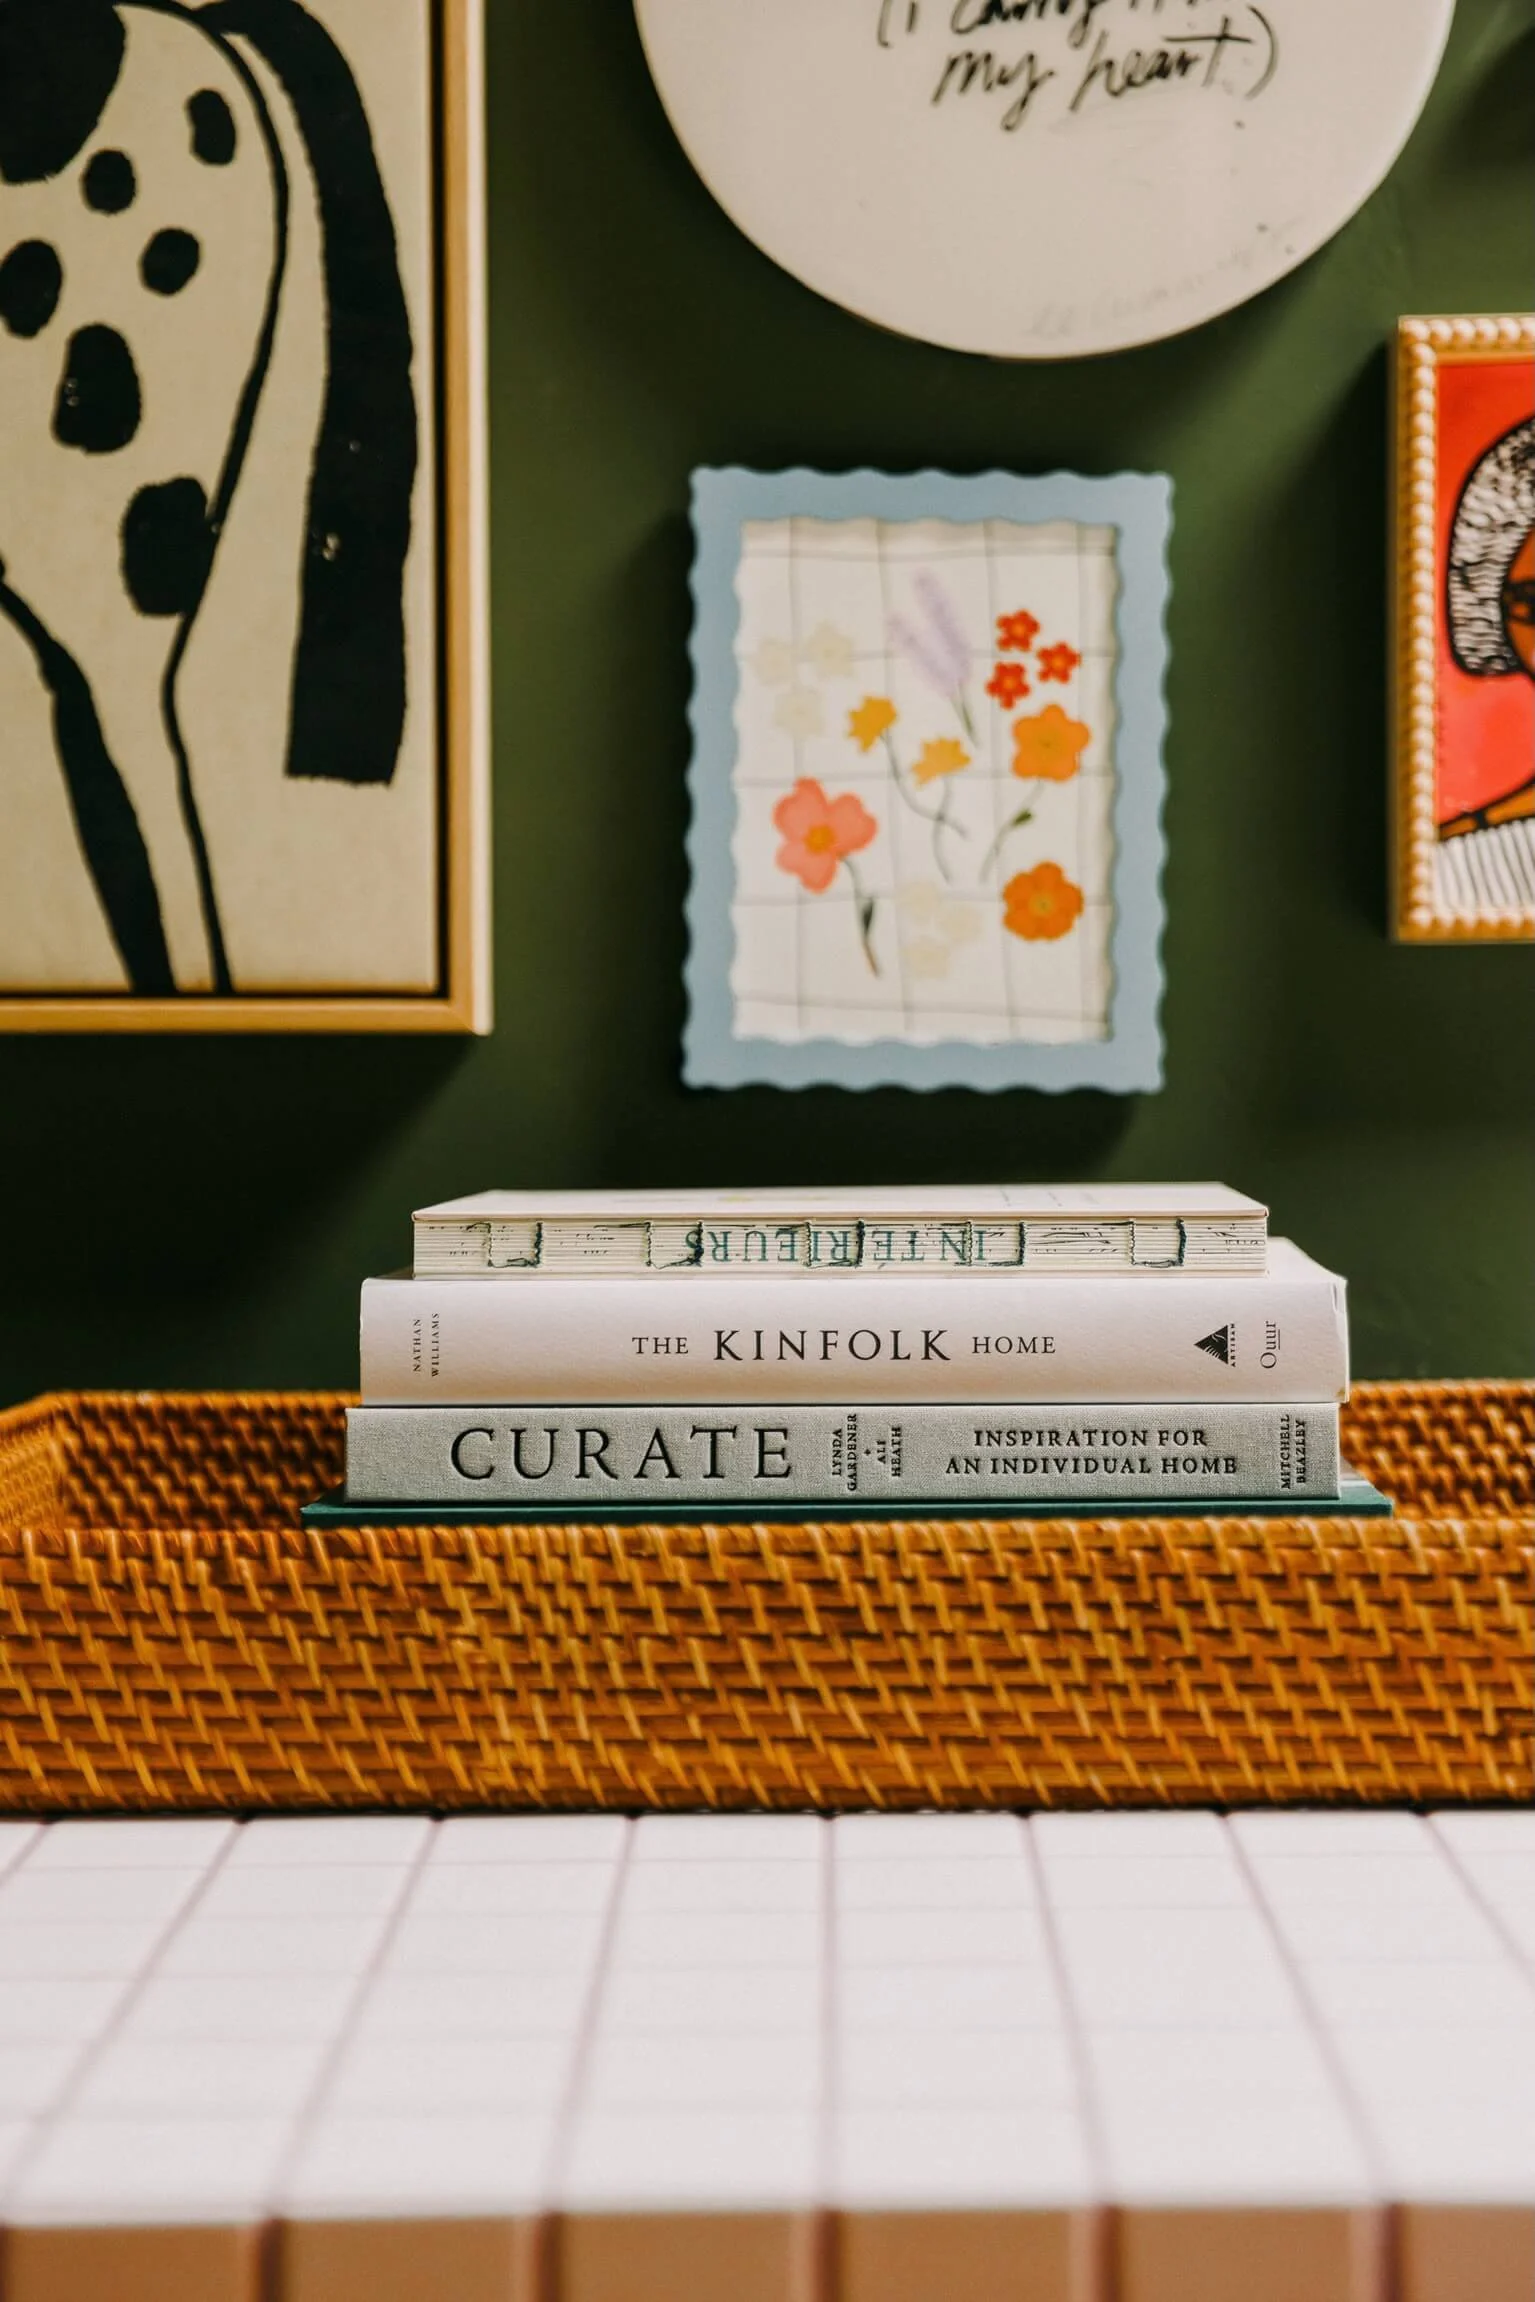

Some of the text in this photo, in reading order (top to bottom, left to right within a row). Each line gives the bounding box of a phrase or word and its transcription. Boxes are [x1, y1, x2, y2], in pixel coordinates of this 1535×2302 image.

[932, 5, 1279, 131] my heart)
[412, 1319, 422, 1372] NATHAN
[431, 1313, 440, 1377] WILLIAMS
[631, 1329, 1056, 1362] THE KINFOLK HOME
[1229, 1322, 1237, 1368] ARTISAN
[1259, 1320, 1281, 1369] Ouur
[450, 1425, 792, 1480] CURATE
[831, 1427, 843, 1477] LYNDA
[847, 1413, 858, 1492] GARDENER
[876, 1439, 887, 1465] ALI
[891, 1425, 903, 1477] HEATH
[974, 1428, 1208, 1447] INSPIRATION FOR
[1279, 1413, 1291, 1490] MITCHELL
[1295, 1418, 1307, 1484] BEAZLEY
[945, 1456, 1238, 1475] AN INDIVIDUAL HOME
